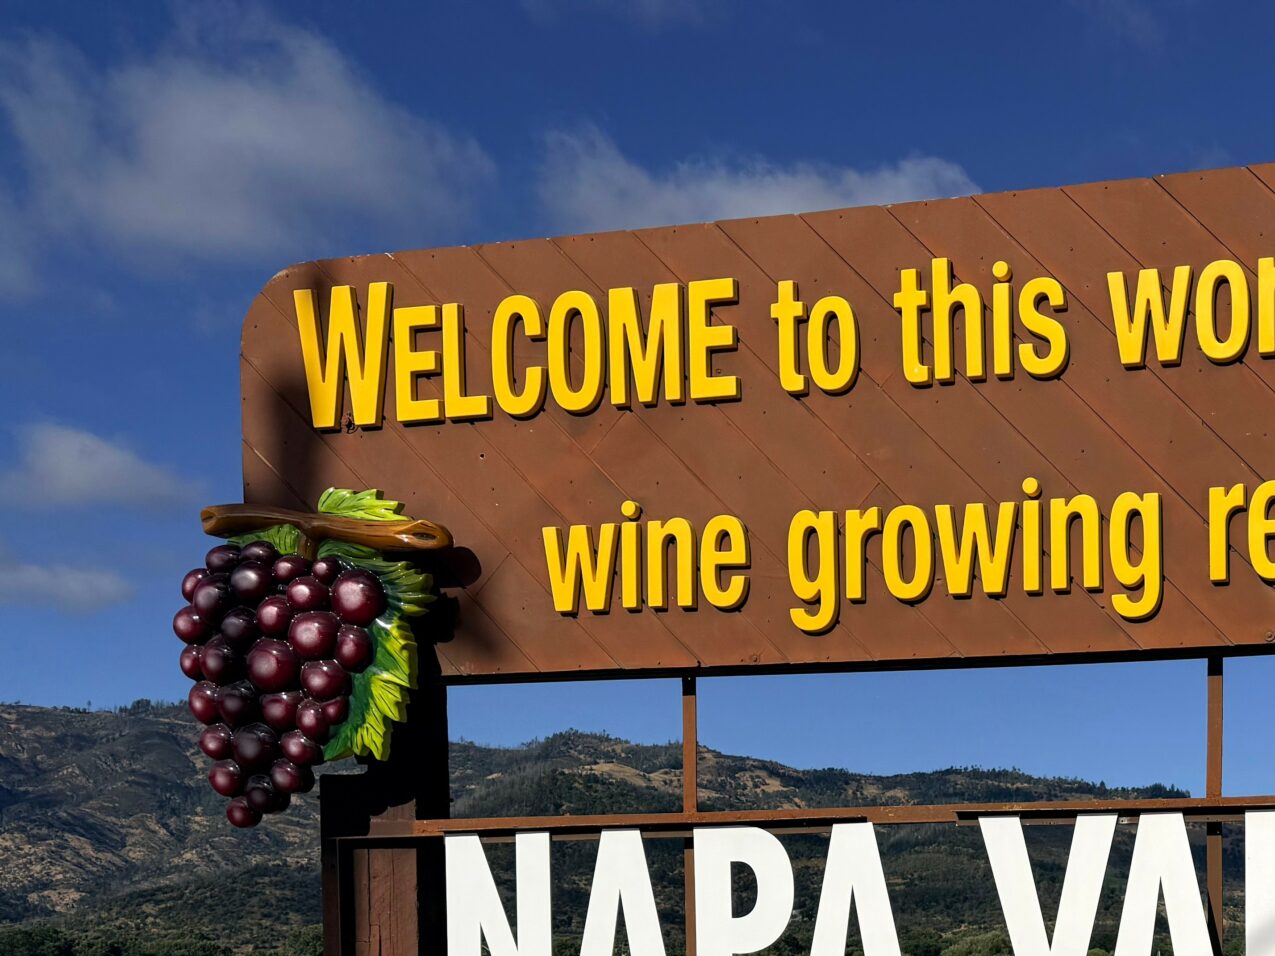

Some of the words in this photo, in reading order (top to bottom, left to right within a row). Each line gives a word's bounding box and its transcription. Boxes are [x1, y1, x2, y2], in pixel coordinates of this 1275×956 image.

[293, 280, 742, 429] WELCOME
[770, 280, 859, 394] to
[893, 257, 1070, 385] this
[541, 500, 749, 615] wine
[787, 477, 1162, 633] growing
